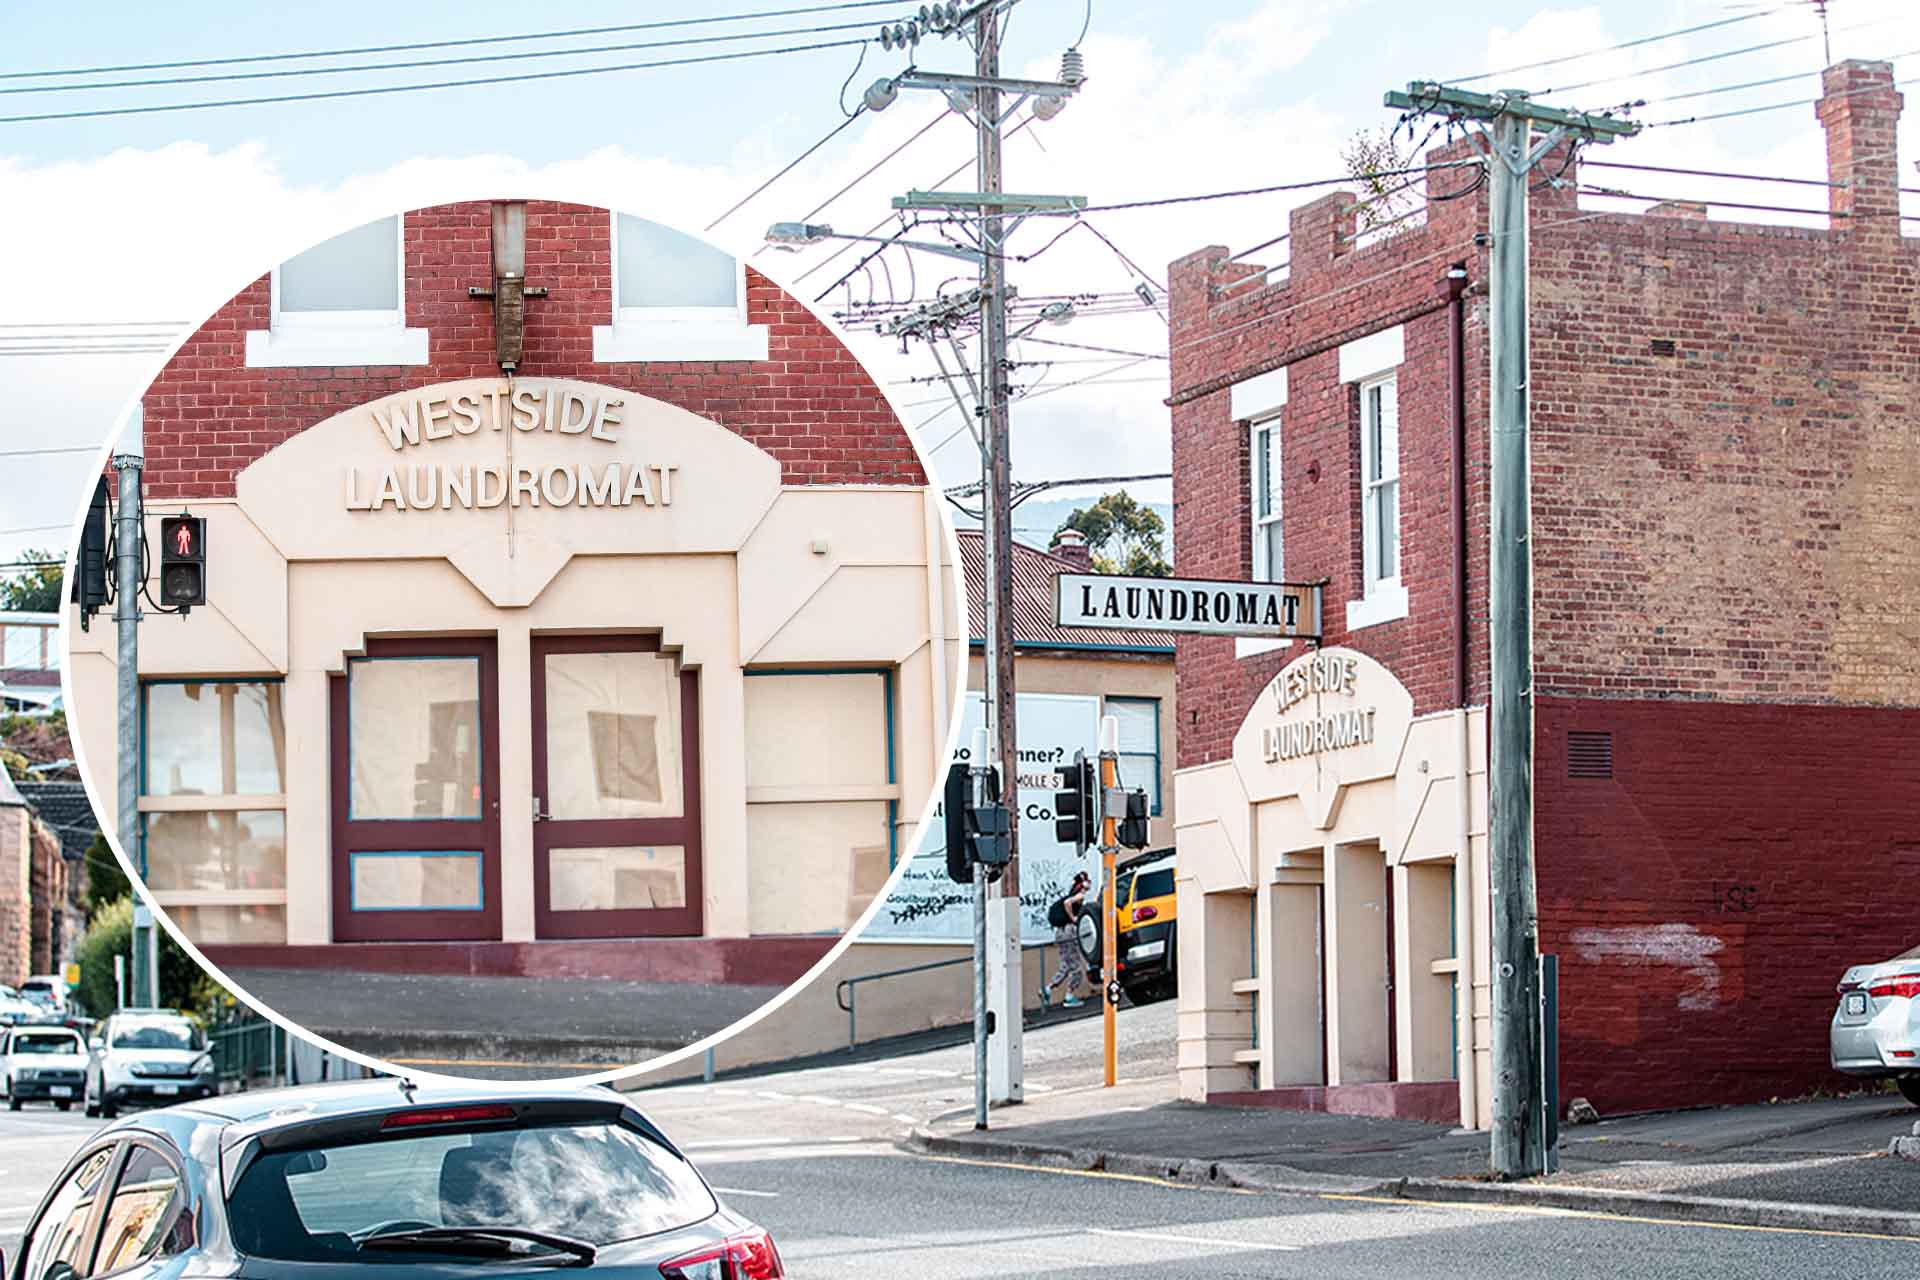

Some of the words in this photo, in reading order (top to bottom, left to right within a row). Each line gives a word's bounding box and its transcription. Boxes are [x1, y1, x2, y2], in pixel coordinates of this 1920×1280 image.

[371, 387, 625, 451] WESTSIDE
[346, 463, 679, 512] LAUNDROMAT
[1080, 584, 1300, 627] LAUNDROMAT
[1272, 656, 1358, 715] WESTSIDE
[1263, 705, 1377, 765] LAUNDROMAT
[1026, 803, 1056, 820] Co.
